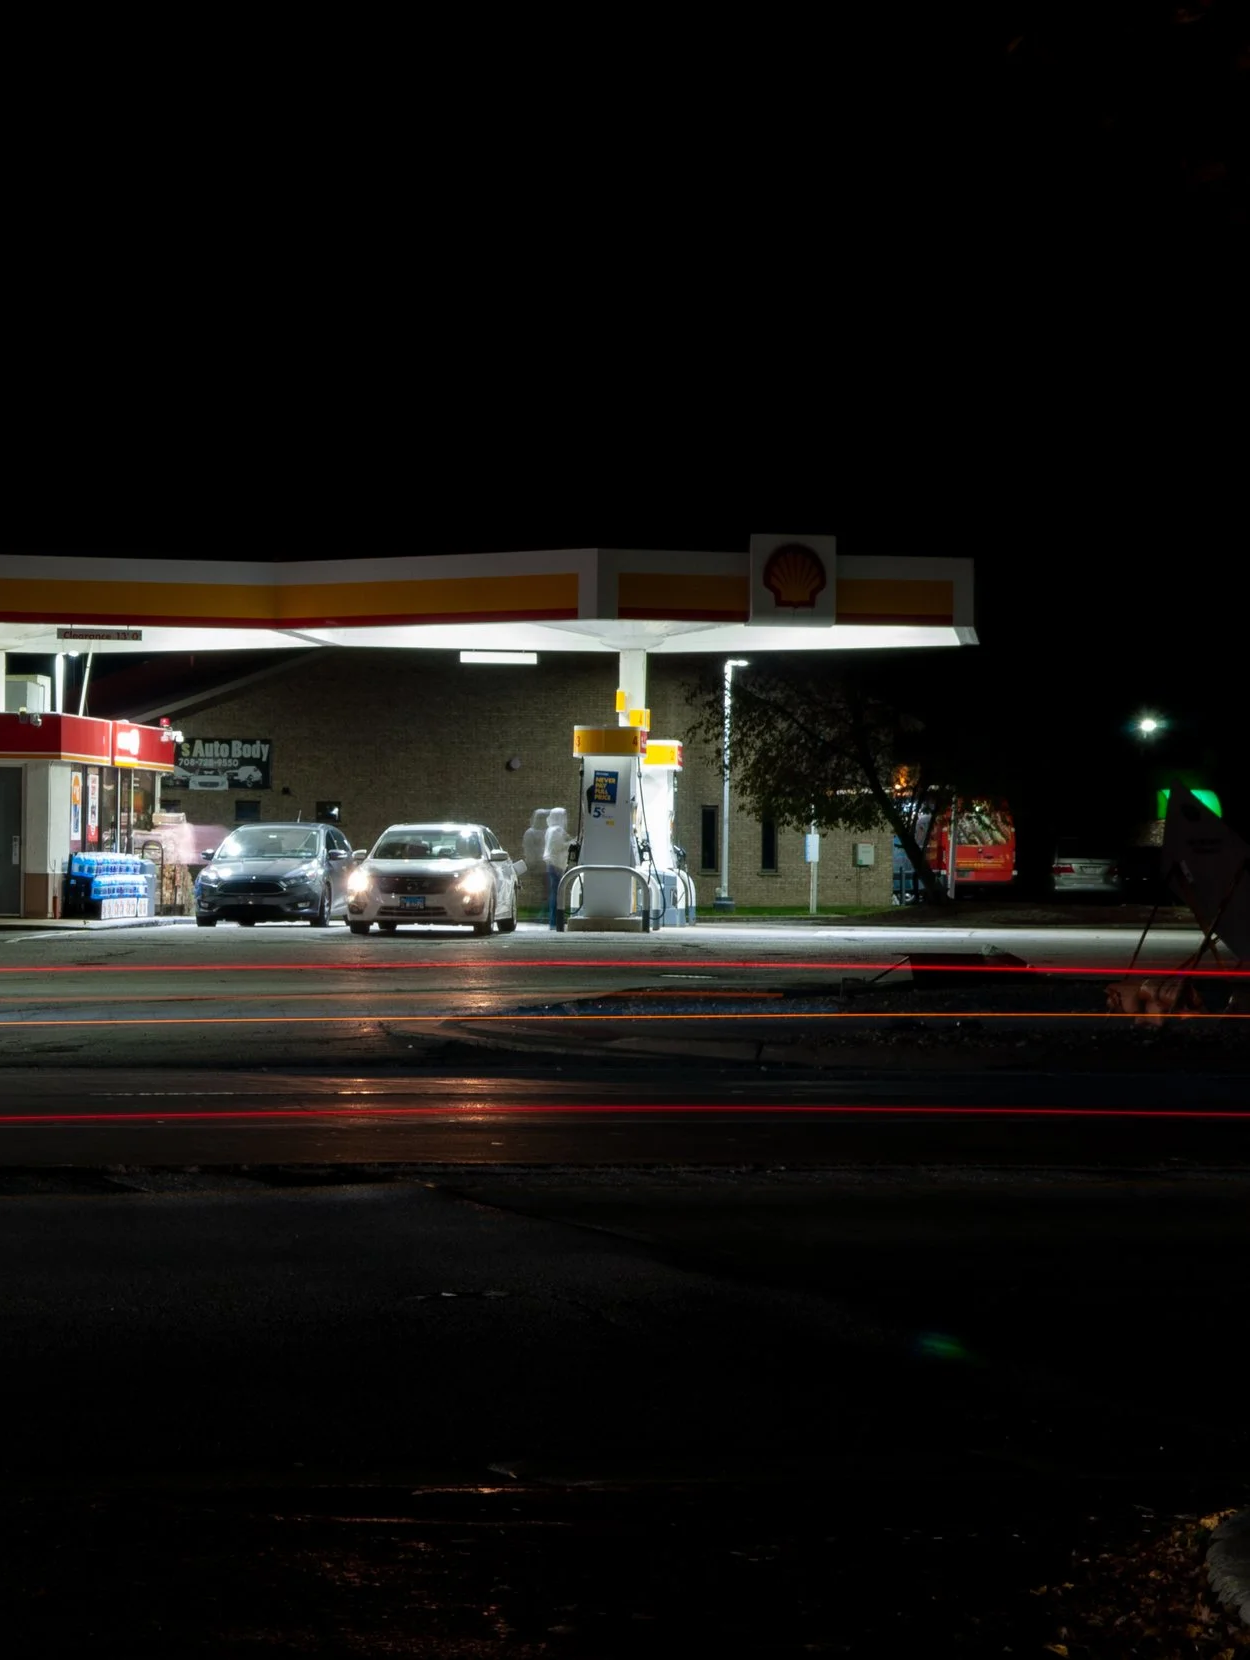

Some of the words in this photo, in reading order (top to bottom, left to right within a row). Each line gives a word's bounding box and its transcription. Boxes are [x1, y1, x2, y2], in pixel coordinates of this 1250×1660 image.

[63, 631, 111, 640] Clearance
[575, 735, 581, 747] 3
[632, 735, 638, 747] 4
[192, 739, 230, 758] Auto
[232, 739, 270, 762] Body
[595, 777, 616, 785] NEVER
